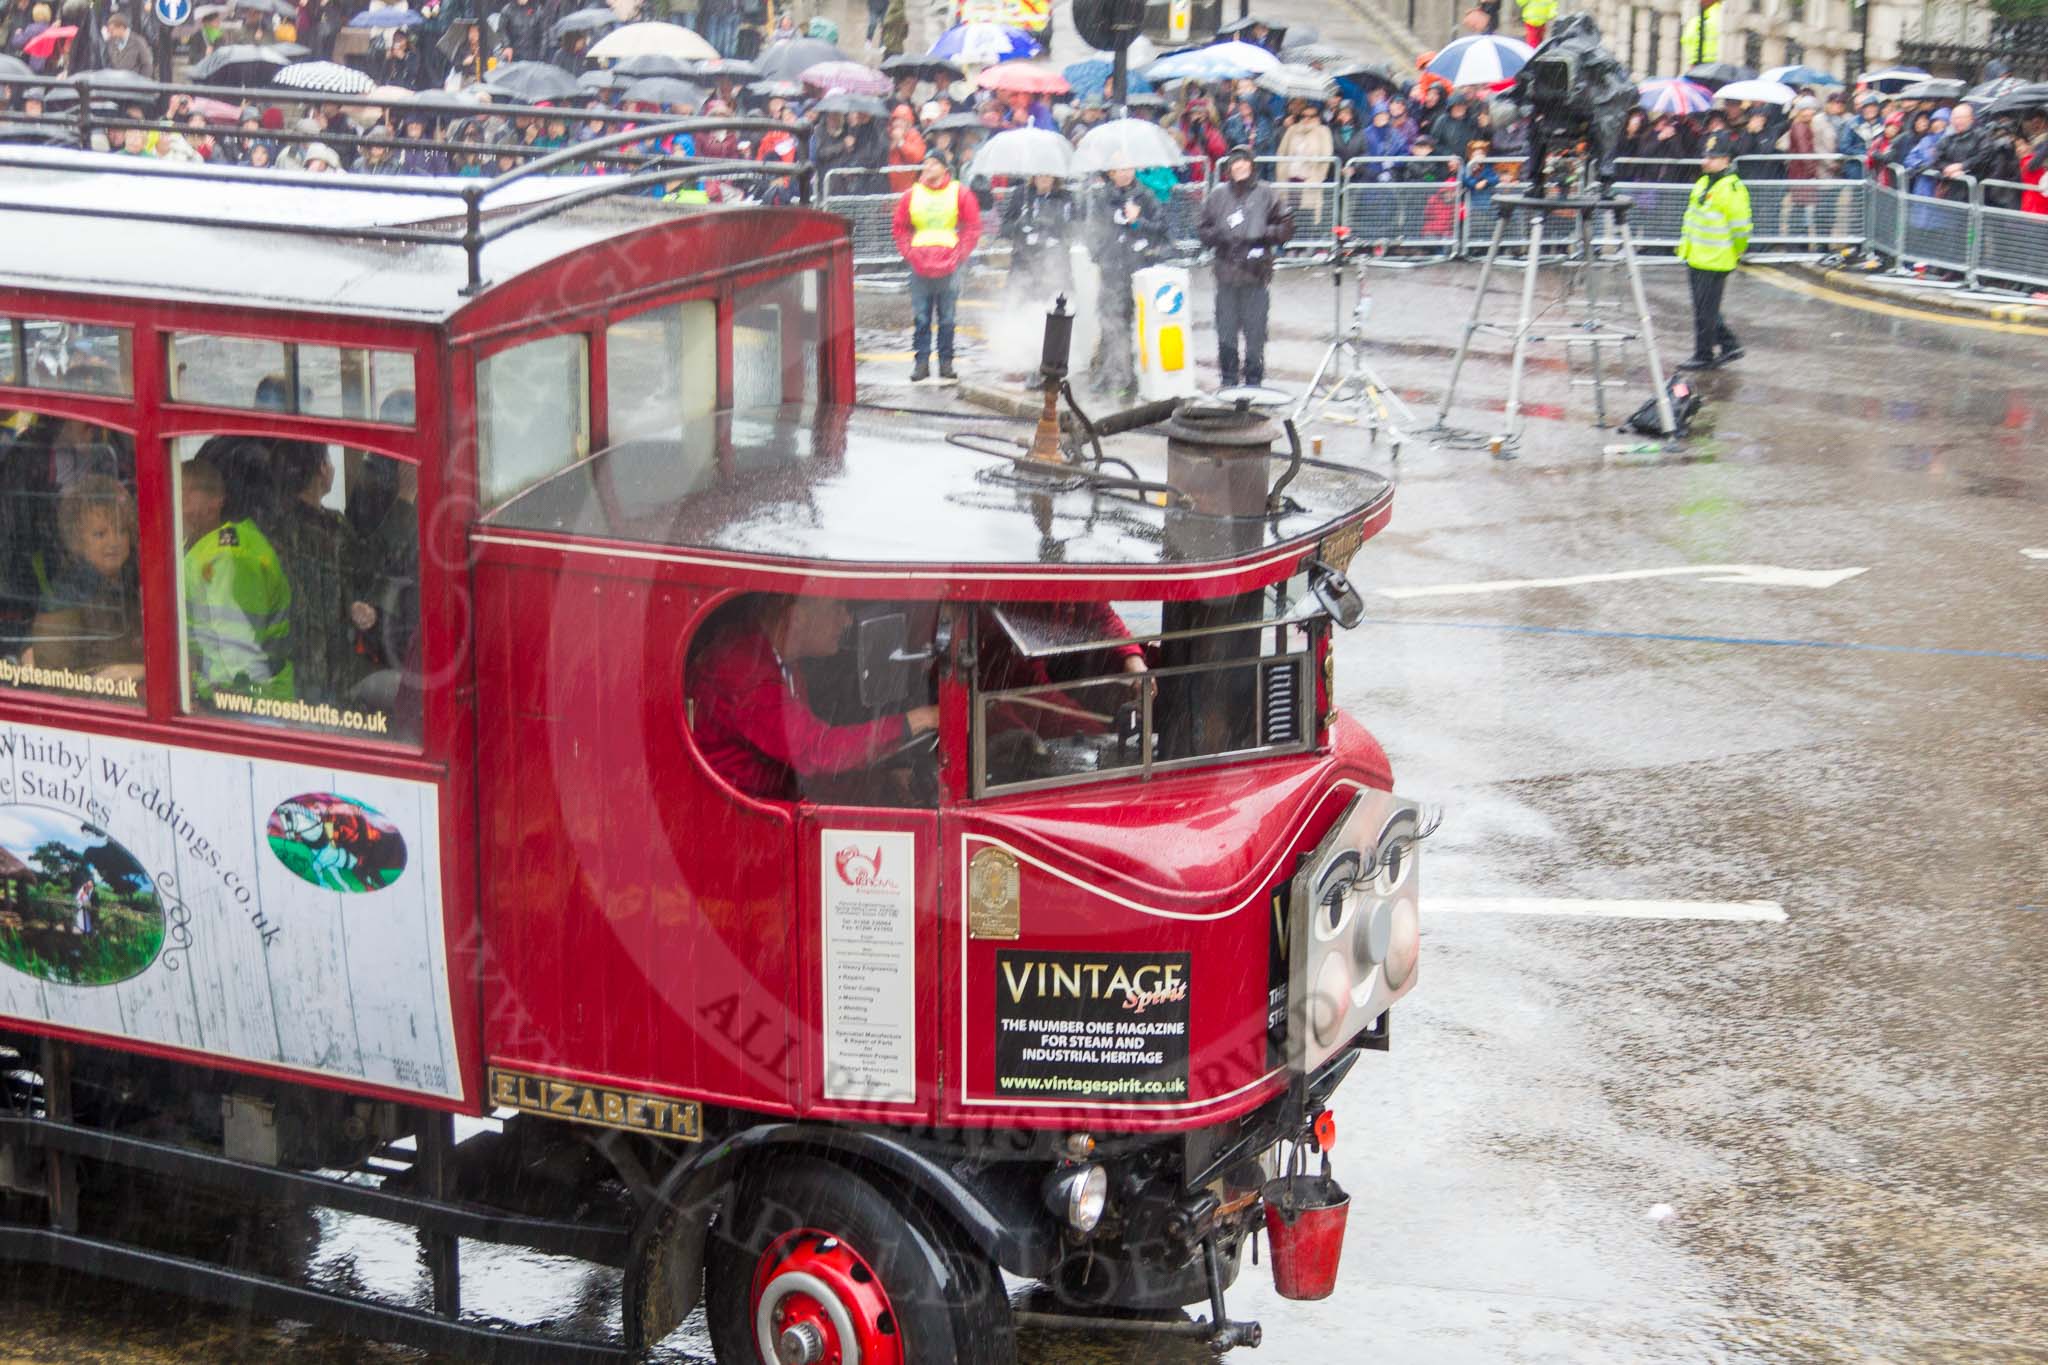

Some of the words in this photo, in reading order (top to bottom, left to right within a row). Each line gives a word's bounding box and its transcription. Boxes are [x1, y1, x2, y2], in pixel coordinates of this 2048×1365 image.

[215, 692, 387, 734] www.crossbutts.co.uk
[21, 770, 112, 828] Stables
[1002, 961, 1183, 1004] VINTAGE
[1122, 980, 1188, 1014] Spirit
[1001, 1019, 1027, 1032] THE
[1029, 1020, 1084, 1033] NUMBER
[1086, 1021, 1114, 1034] ONE
[1115, 1022, 1185, 1035] MAGAZINE
[1041, 1035, 1067, 1047] FOR
[1069, 1036, 1113, 1049] STEAM
[1115, 1037, 1144, 1050] AND
[1023, 1048, 1099, 1062] INDUSTRIAL
[1101, 1051, 1163, 1064] HERITAGE
[1000, 1076, 1185, 1095] www.vintagespirit.co.uk
[496, 1074, 696, 1134] ELIZABETH
